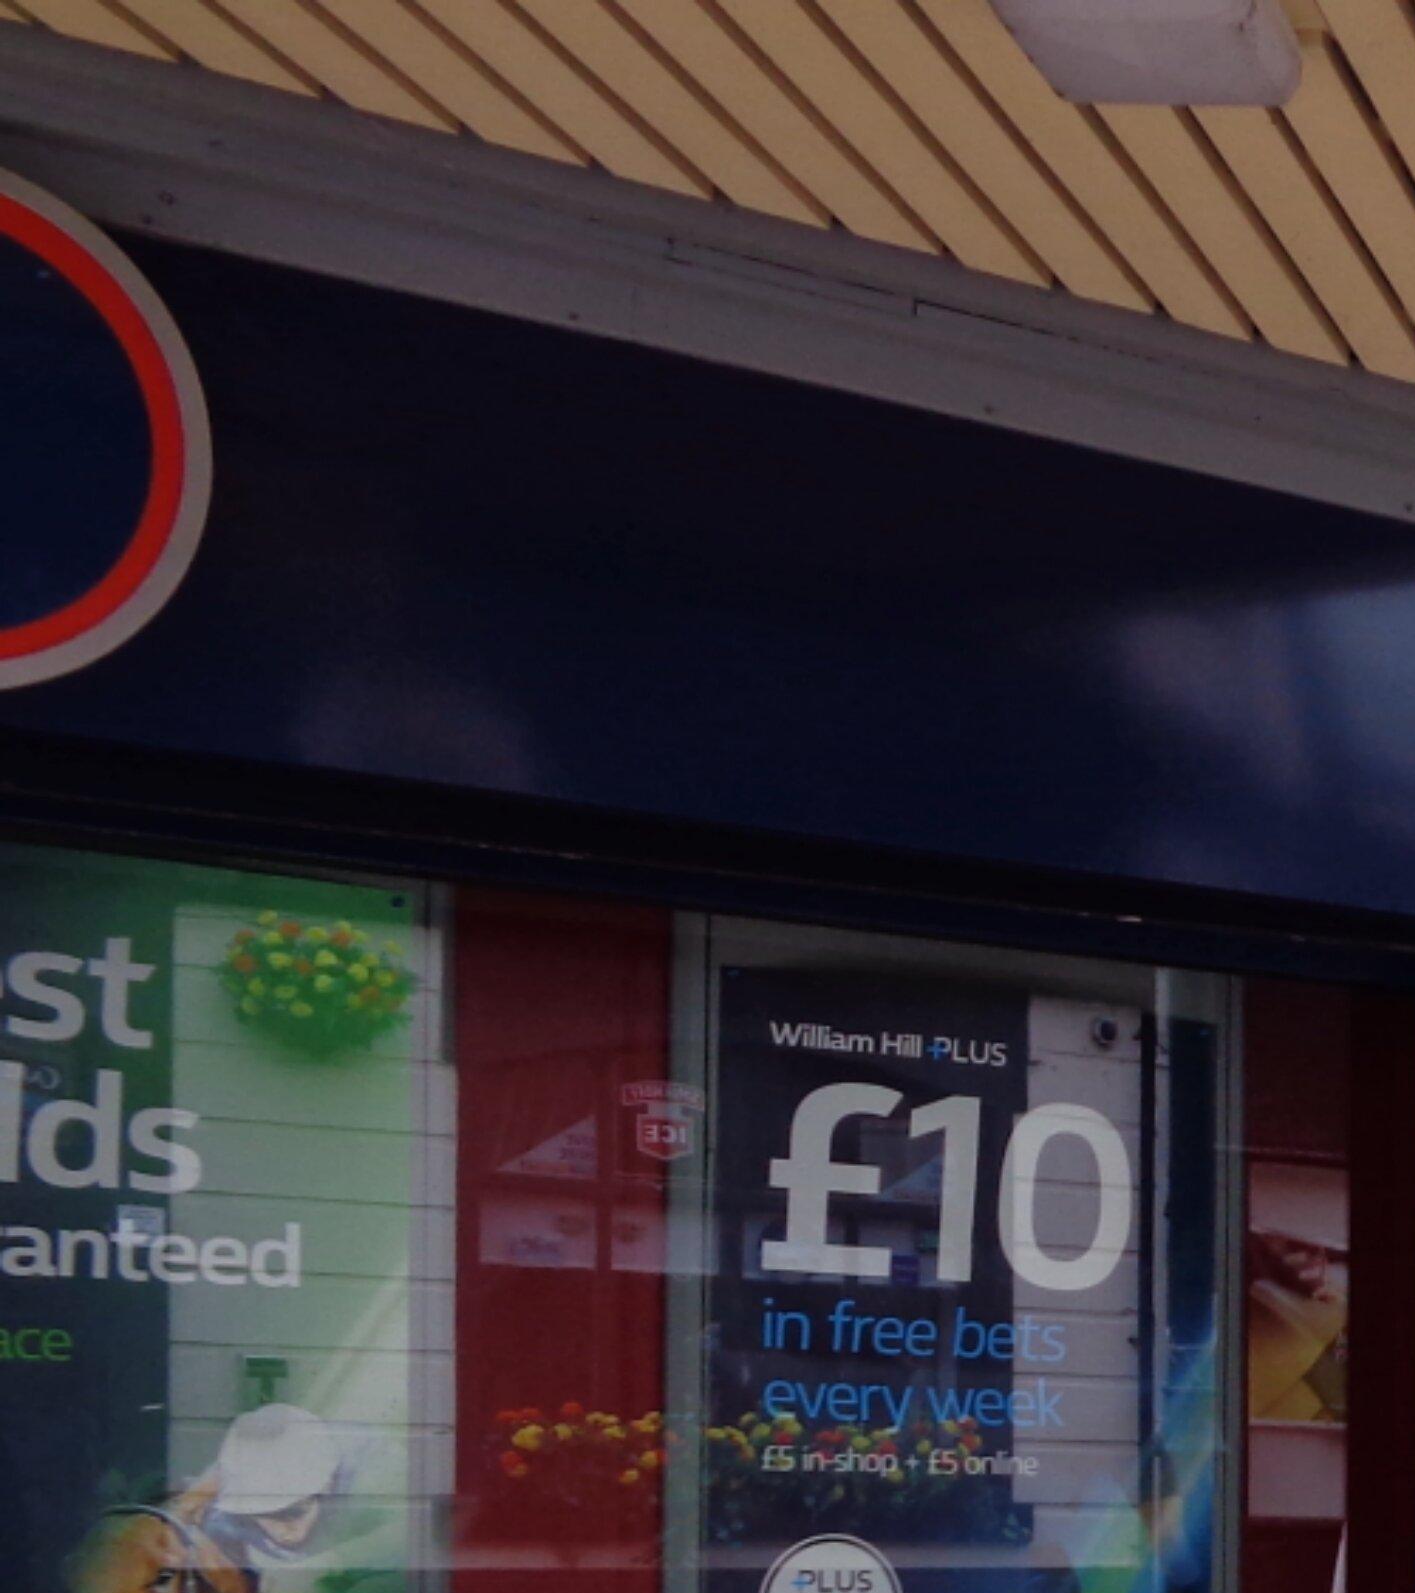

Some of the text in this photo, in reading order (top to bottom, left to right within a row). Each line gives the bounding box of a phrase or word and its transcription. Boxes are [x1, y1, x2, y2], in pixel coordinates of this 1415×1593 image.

[769, 1020, 873, 1055] William
[880, 1031, 923, 1058] Hill
[760, 1081, 1134, 1291] £10
[762, 1298, 1067, 1363] in free bets
[762, 1378, 1064, 1434] every week
[760, 1443, 795, 1473] £5
[802, 1444, 898, 1477] in-shop
[928, 1448, 957, 1475] £5
[964, 1451, 1040, 1476] online
